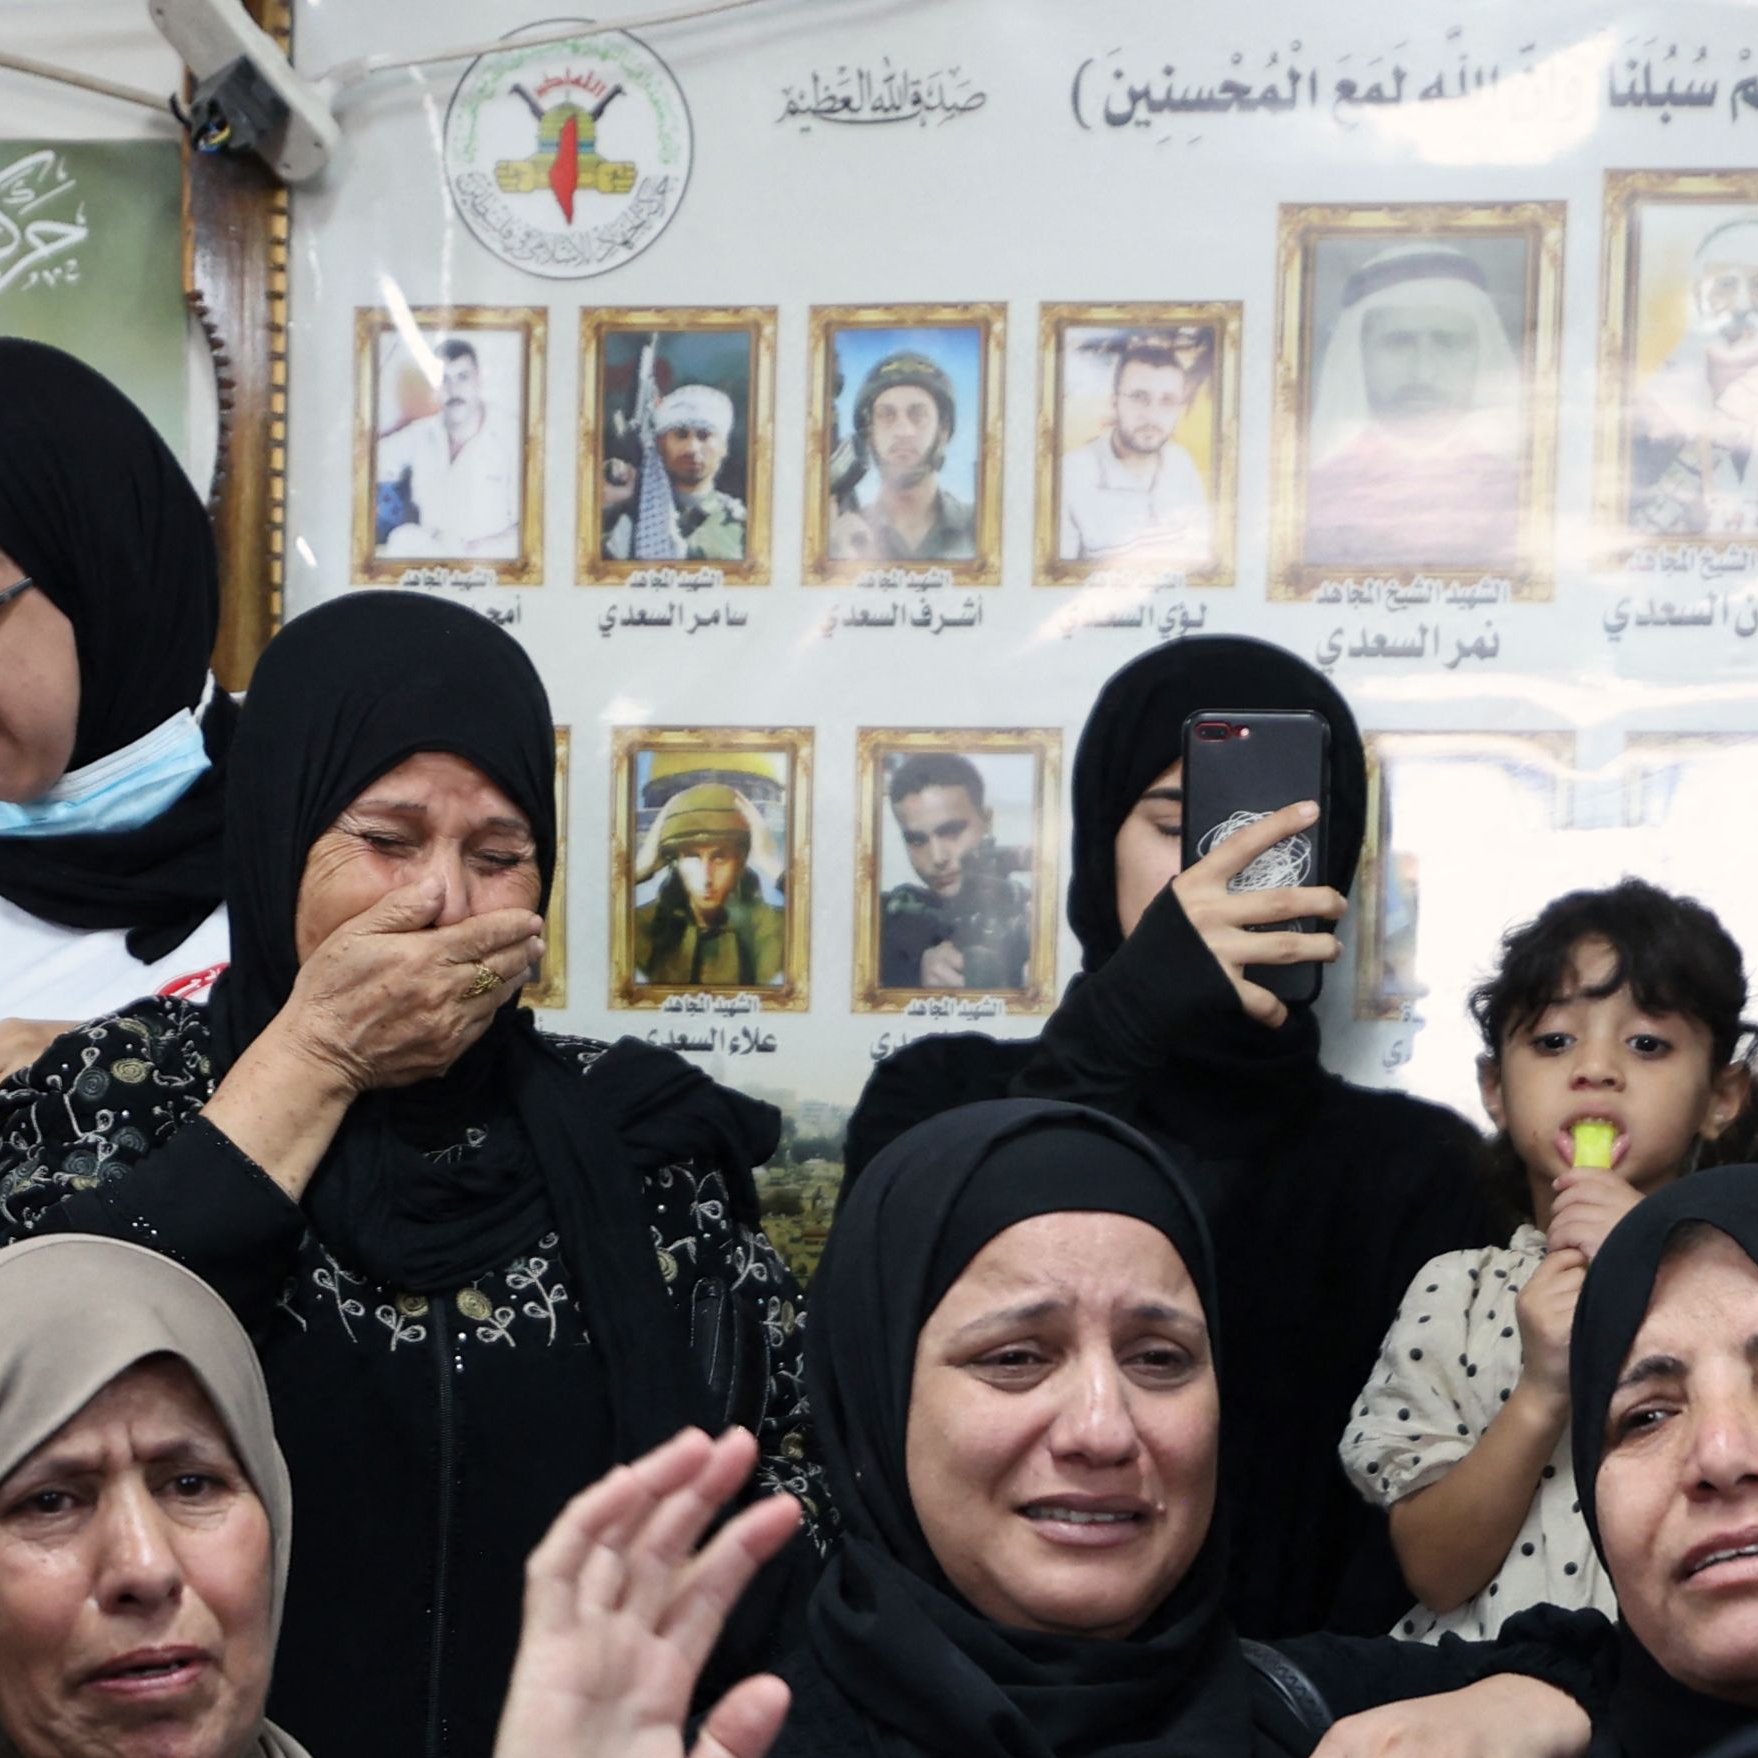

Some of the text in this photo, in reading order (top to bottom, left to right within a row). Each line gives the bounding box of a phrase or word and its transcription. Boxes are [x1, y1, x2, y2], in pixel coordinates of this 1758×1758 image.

[1316, 577, 1510, 612] الشهيد الشيخ المجاهد
[598, 601, 748, 638] سامر السعدي
[911, 594, 983, 636] أشرف
[1315, 619, 1501, 675] نمر السعدي
[729, 1025, 779, 1056] علاء
